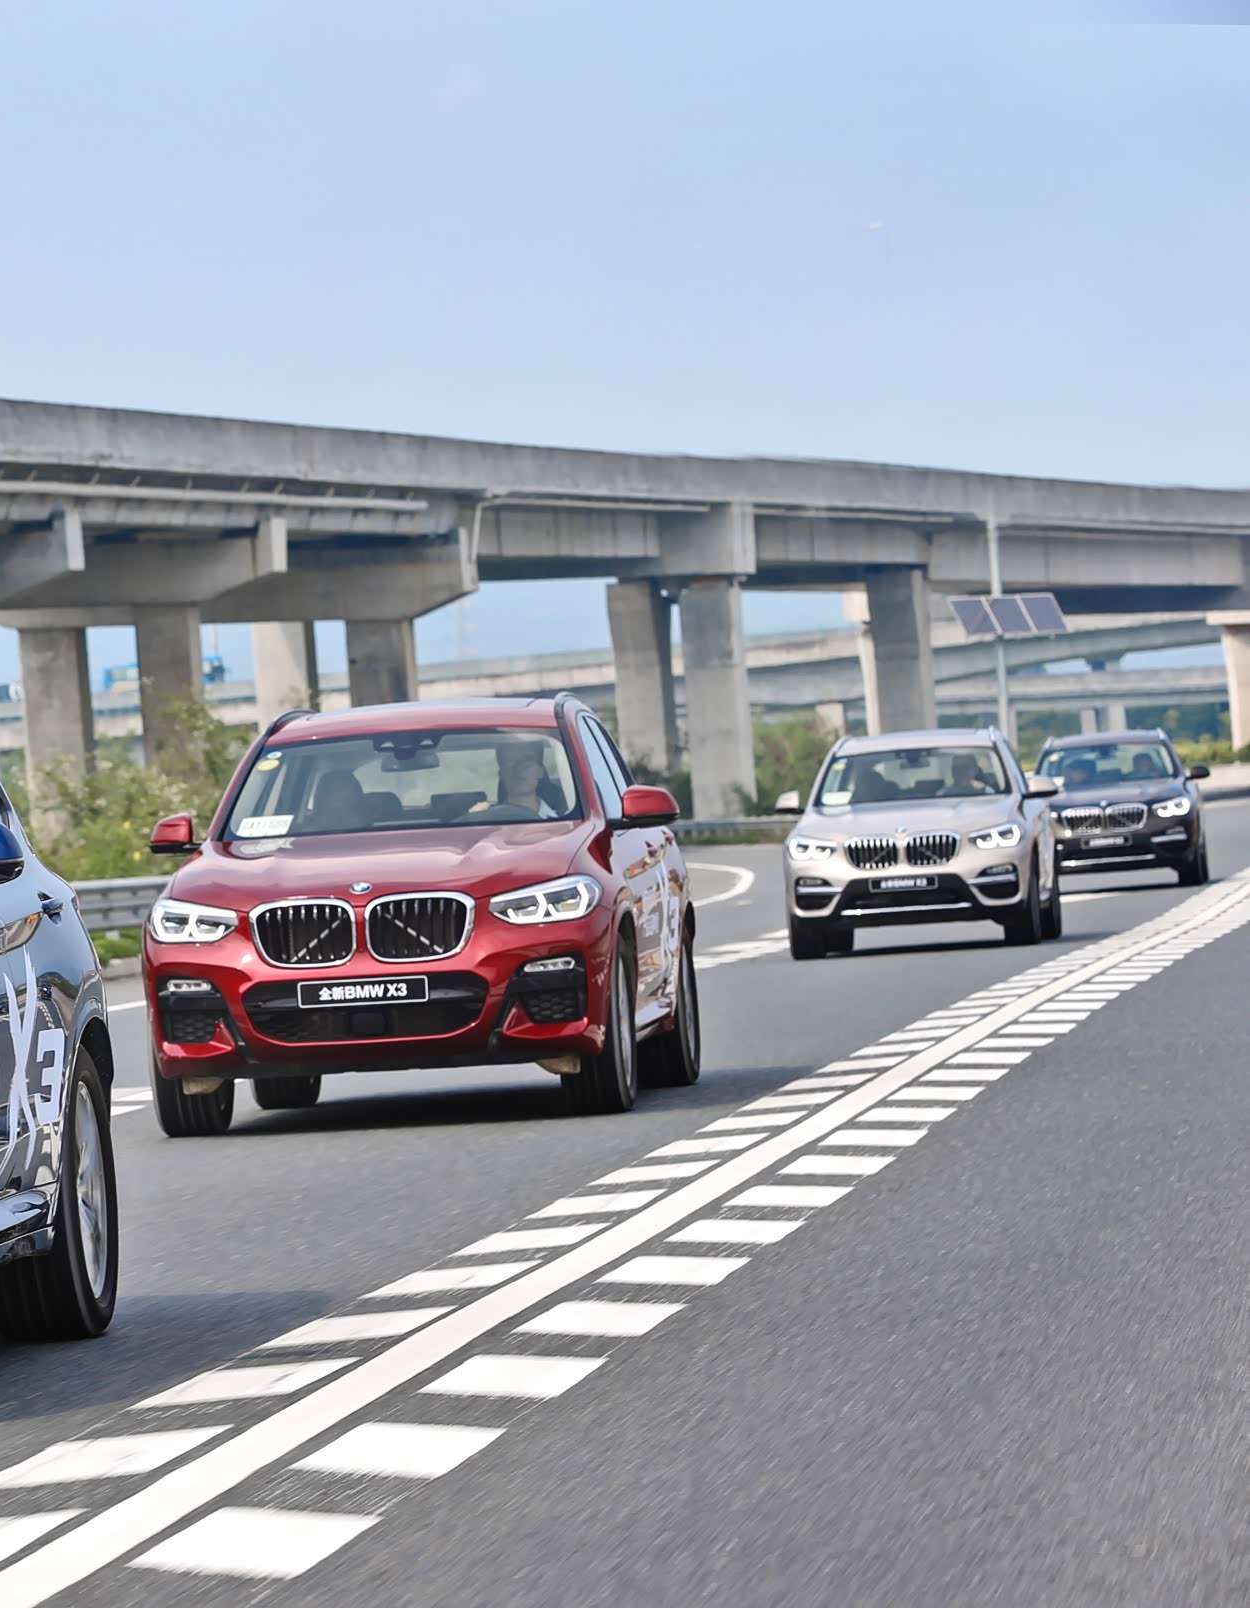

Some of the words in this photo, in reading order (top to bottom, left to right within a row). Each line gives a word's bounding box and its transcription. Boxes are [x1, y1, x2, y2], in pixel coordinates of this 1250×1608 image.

[319, 983, 385, 1001] 全新BMW
[386, 983, 408, 997] X3
[1, 944, 65, 1172] X3
